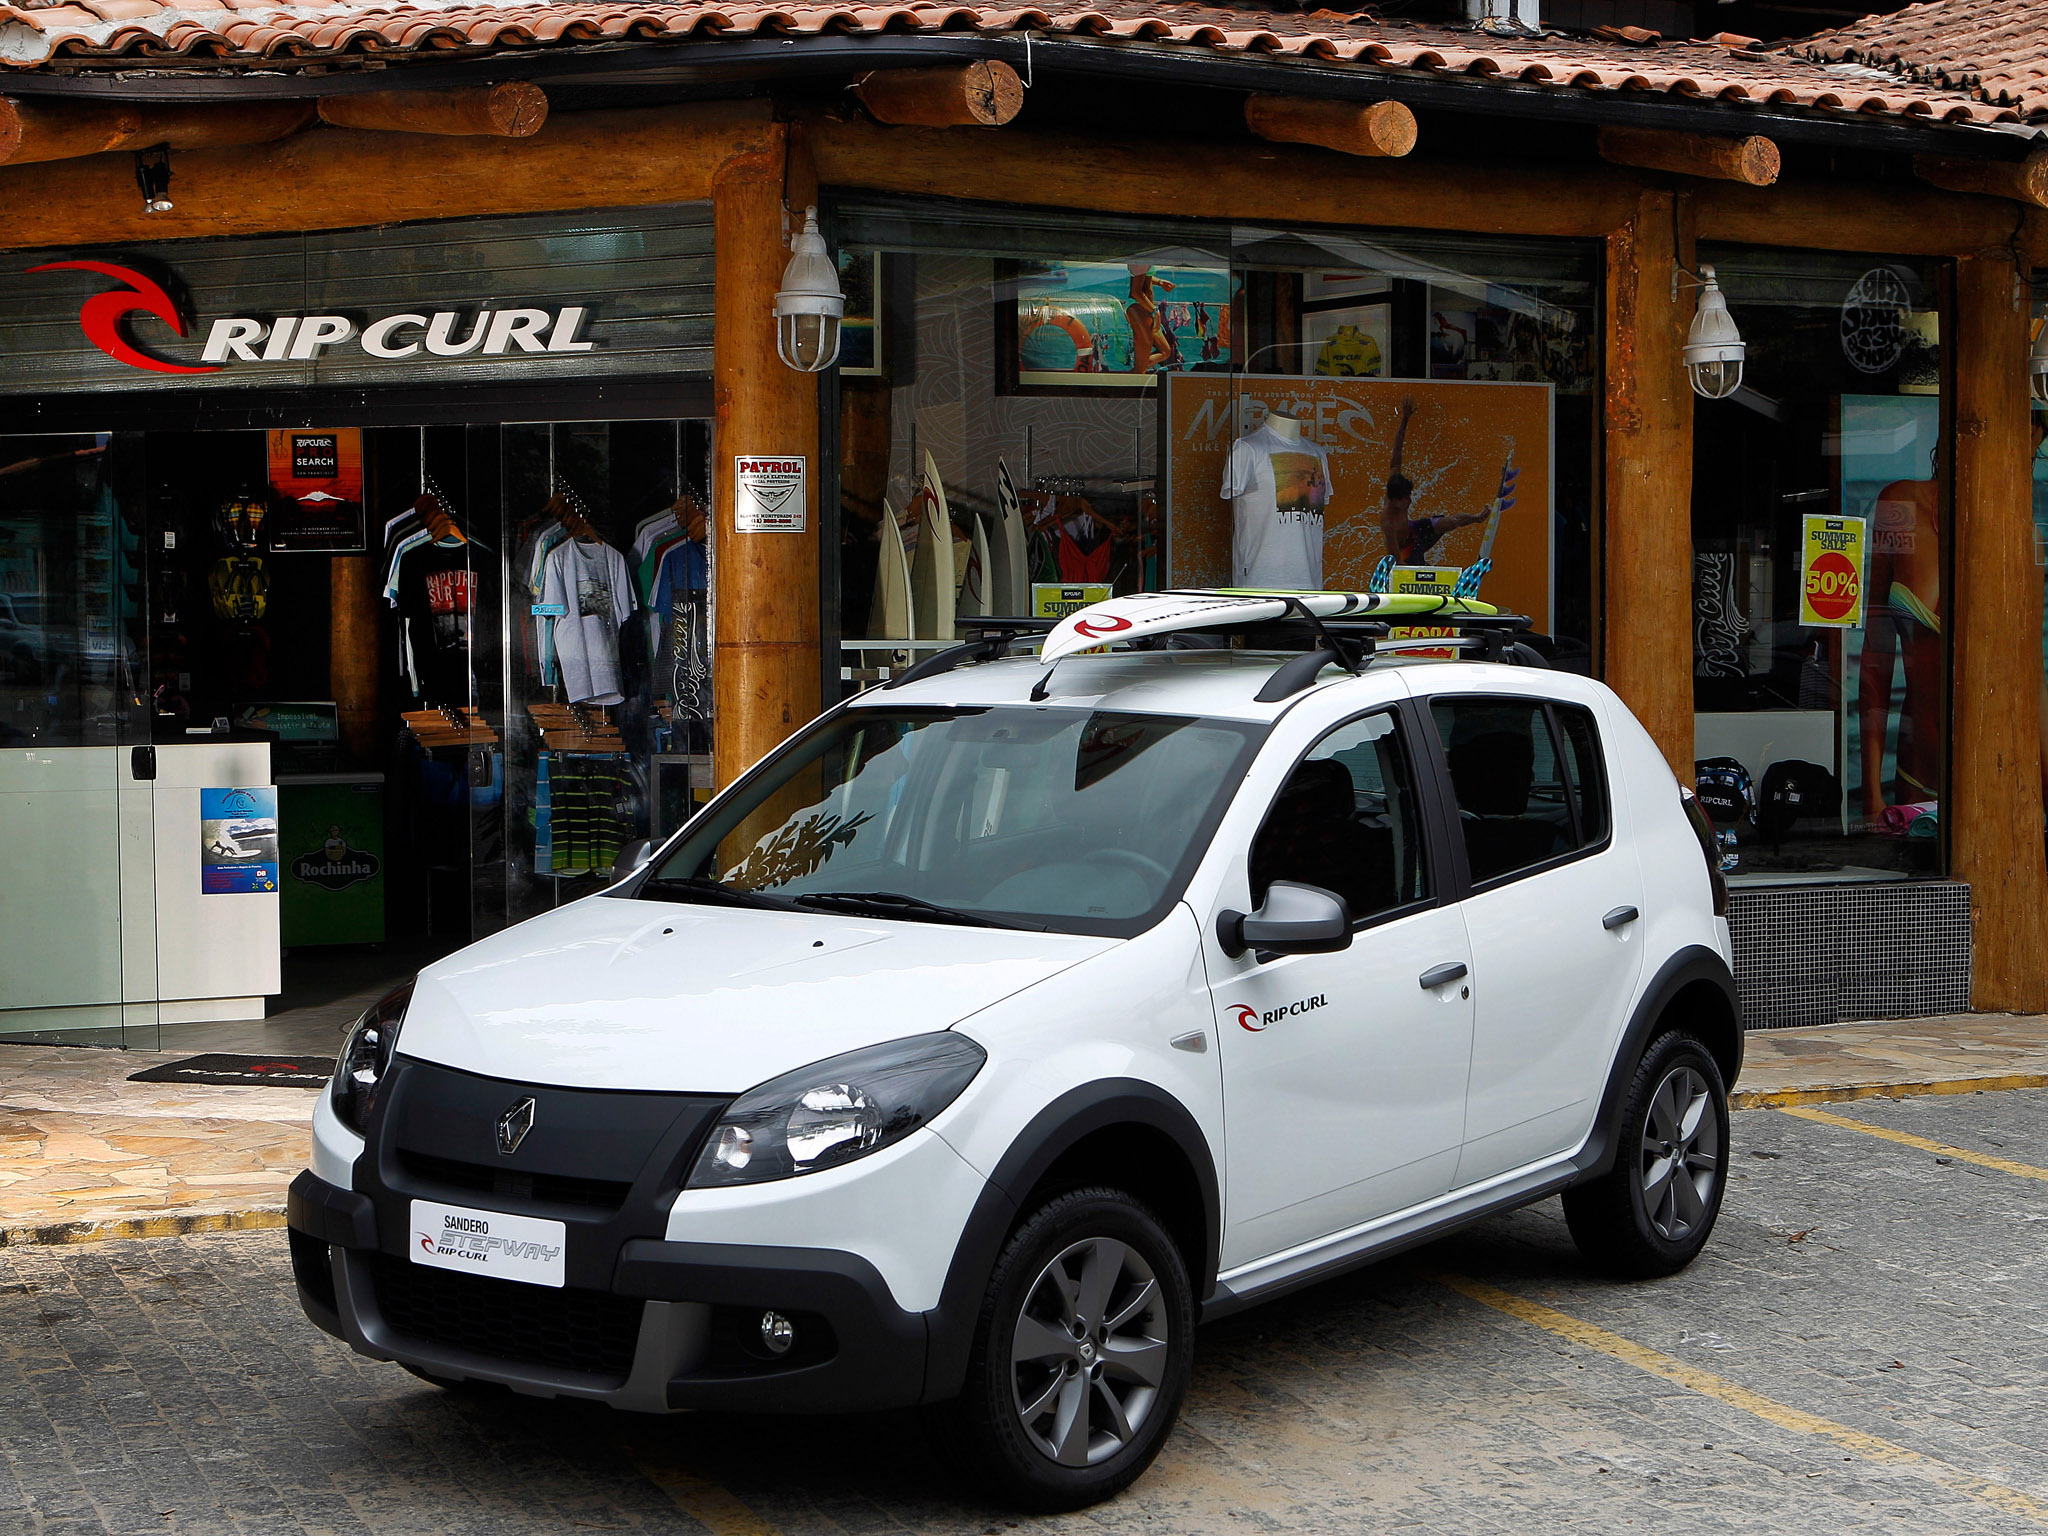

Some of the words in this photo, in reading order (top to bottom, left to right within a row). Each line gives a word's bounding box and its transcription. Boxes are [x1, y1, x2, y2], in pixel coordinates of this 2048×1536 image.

[200, 316, 358, 363] RIP
[360, 306, 598, 358] CURL
[1184, 399, 1338, 442] MRAGE
[296, 447, 333, 457] PRO
[1192, 442, 1219, 451] LIKE
[296, 458, 334, 466] SEARCH
[740, 462, 801, 473] PATROL
[1811, 531, 1857, 542] SUMMER
[1821, 541, 1847, 551] SALE
[1399, 584, 1451, 595] SUMMER
[1806, 570, 1858, 597] 50%
[1044, 602, 1088, 613] SUMME
[300, 861, 371, 876] Rochinha
[1263, 1006, 1288, 1025] RIP
[1290, 993, 1328, 1016] CURL
[444, 1215, 489, 1234] SANDERO
[439, 1229, 561, 1261] STEPWAY
[437, 1246, 456, 1256] RIP
[457, 1248, 489, 1262] CURL
